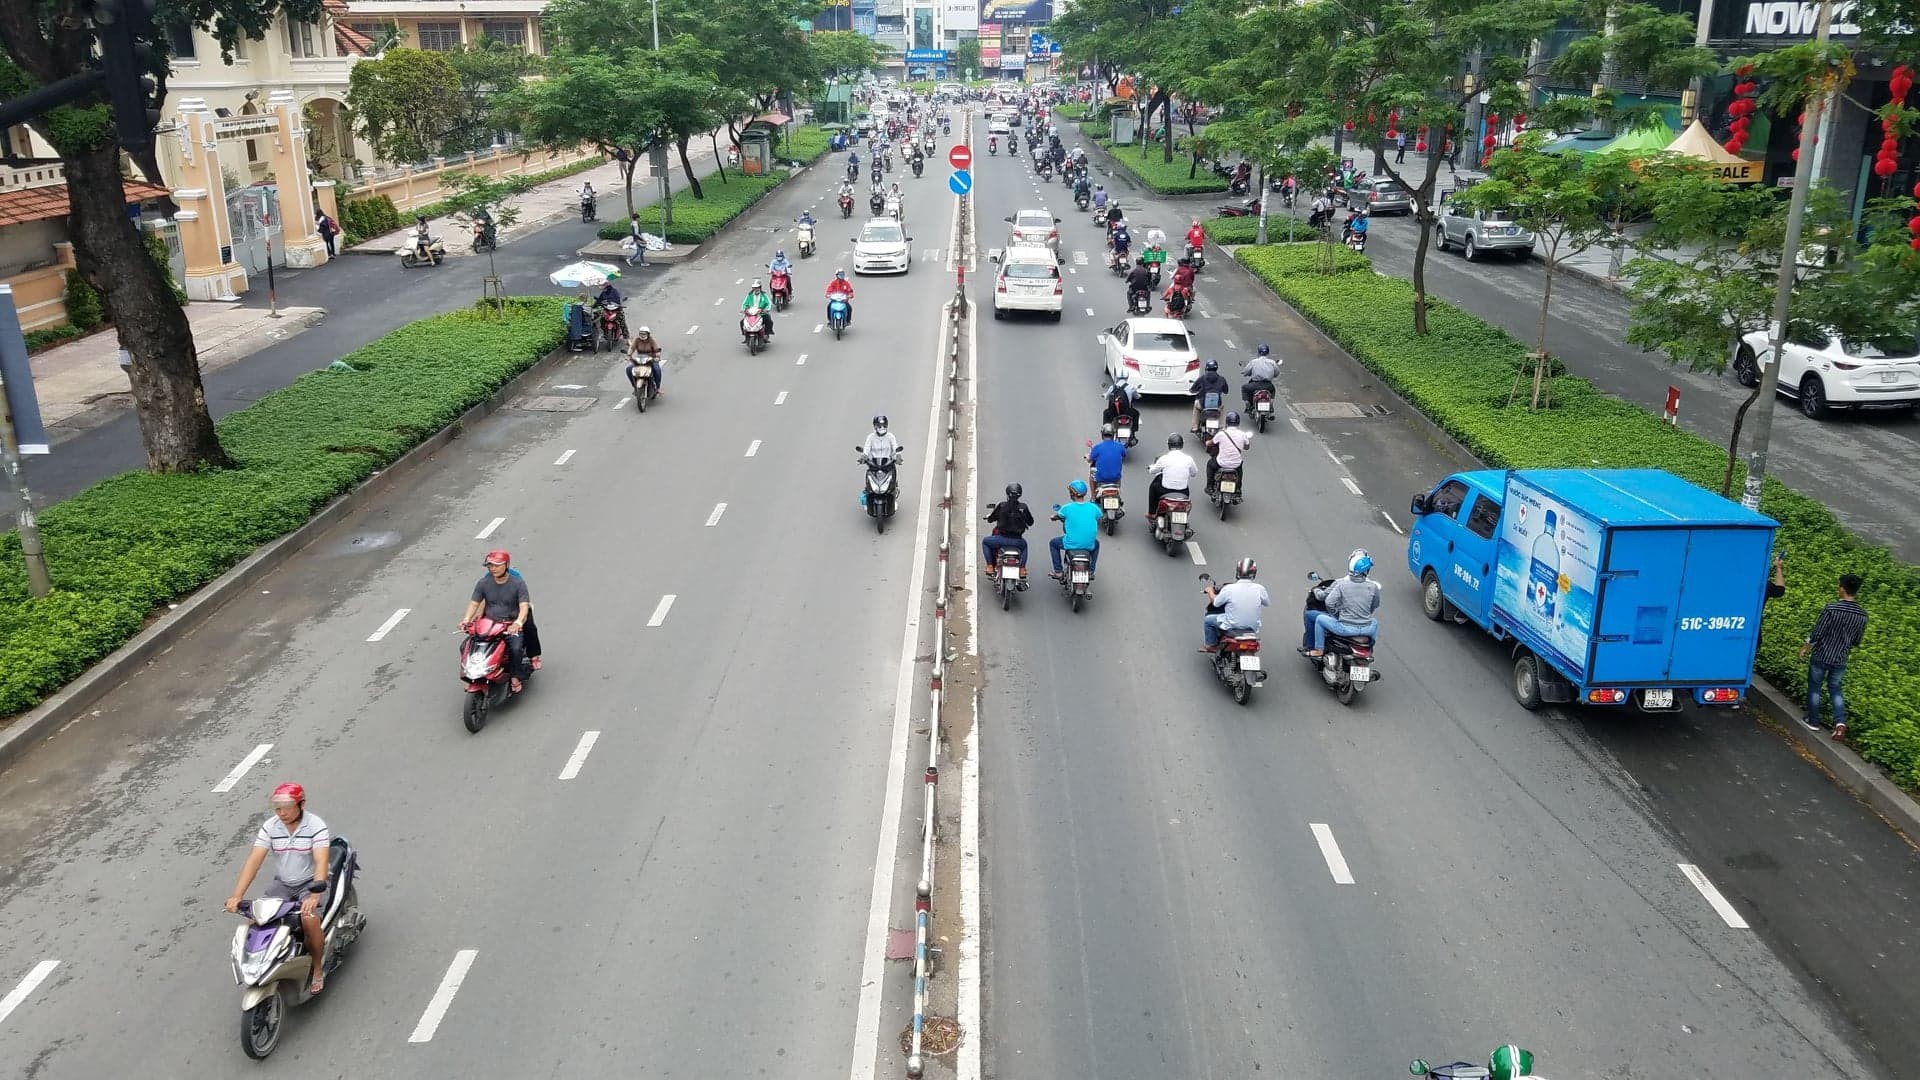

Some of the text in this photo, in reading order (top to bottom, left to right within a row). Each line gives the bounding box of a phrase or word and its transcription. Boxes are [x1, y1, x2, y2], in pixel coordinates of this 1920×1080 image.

[1745, 1, 1821, 34] NOW
[1712, 167, 1750, 179] SALE
[1681, 616, 1745, 630] 51C-39472
